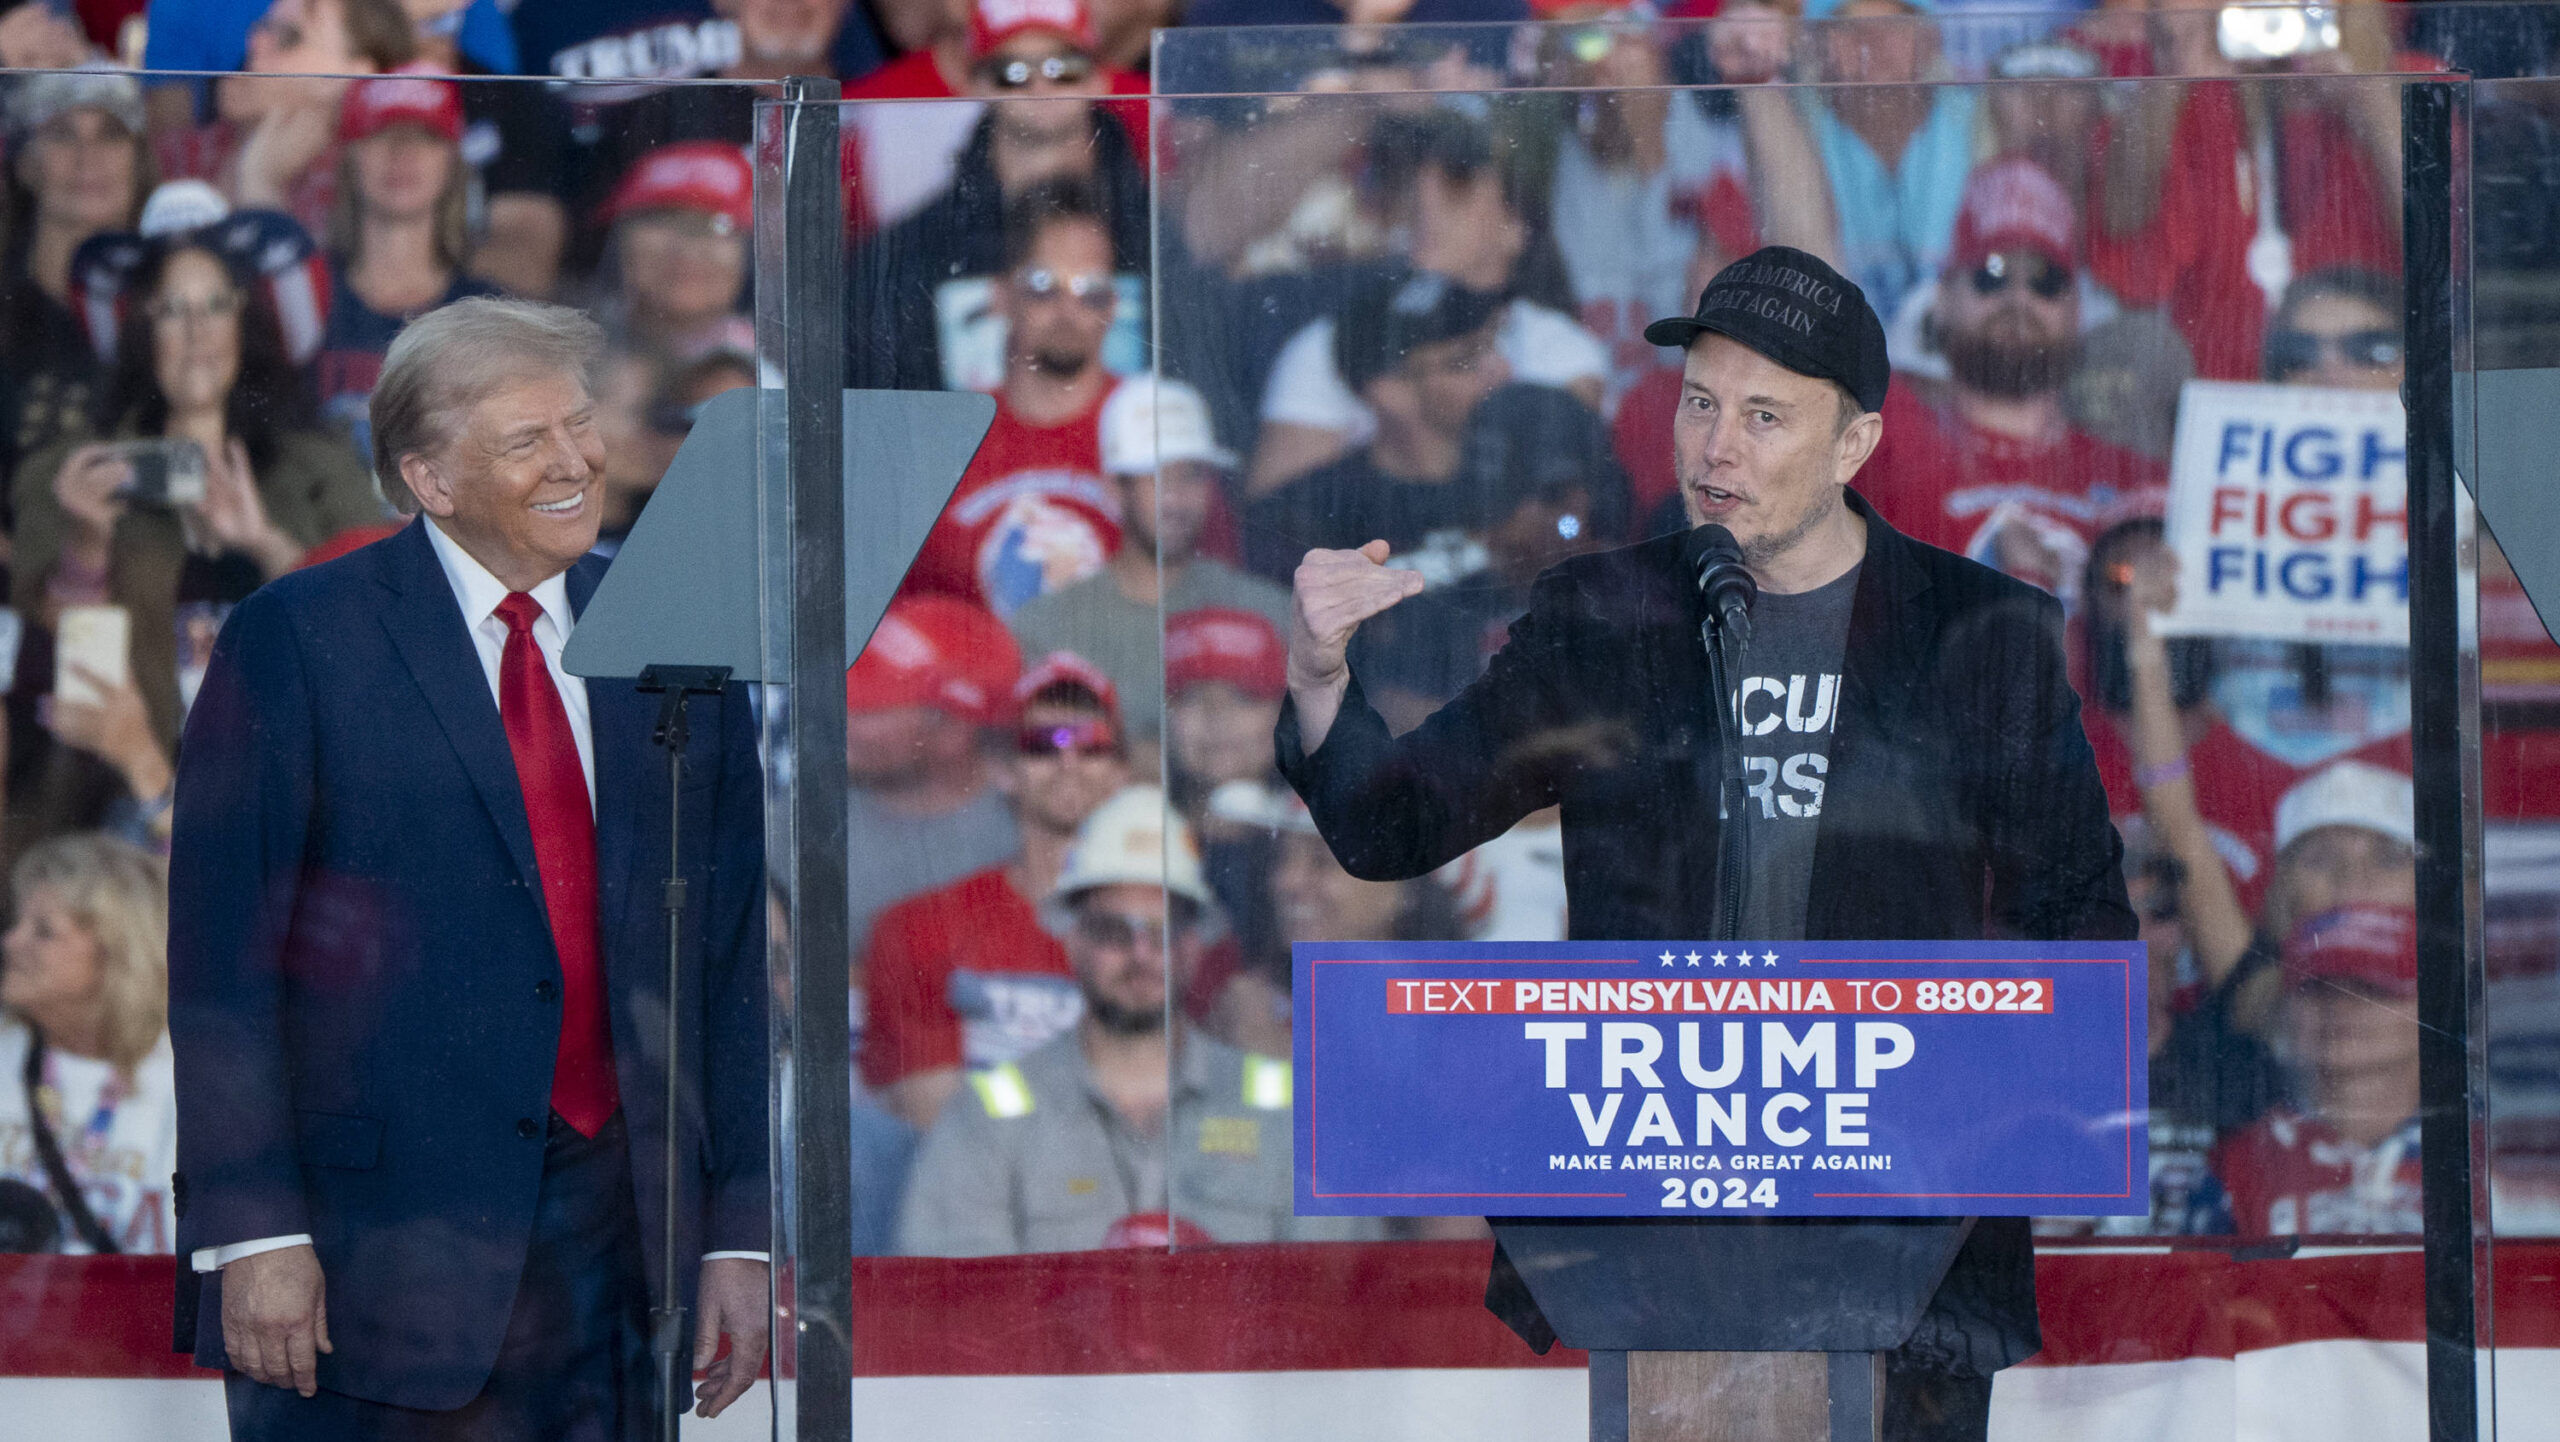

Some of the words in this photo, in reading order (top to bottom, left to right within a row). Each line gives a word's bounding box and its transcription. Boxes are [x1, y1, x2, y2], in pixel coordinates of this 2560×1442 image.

[1744, 292, 1818, 336] AGAIN
[1747, 263, 1843, 316] AMERICA
[2217, 420, 2406, 482] FIGH
[2210, 486, 2407, 544] FIGH
[2208, 545, 2408, 603] FIGH
[1396, 981, 1502, 1012] TEXT
[1515, 980, 1836, 1012] PENNSYLVANIA
[1846, 980, 1903, 1012] TO
[1915, 980, 2044, 1012] 88022
[1524, 1021, 1916, 1090] TRUMP
[1568, 1091, 1870, 1148] VANCE
[1549, 1154, 1613, 1171] MAKE
[1619, 1154, 1723, 1171] AMERICA
[1729, 1154, 1804, 1171] GREAT
[1811, 1154, 1892, 1171] AGAIN!
[1660, 1176, 1780, 1209] 2024
